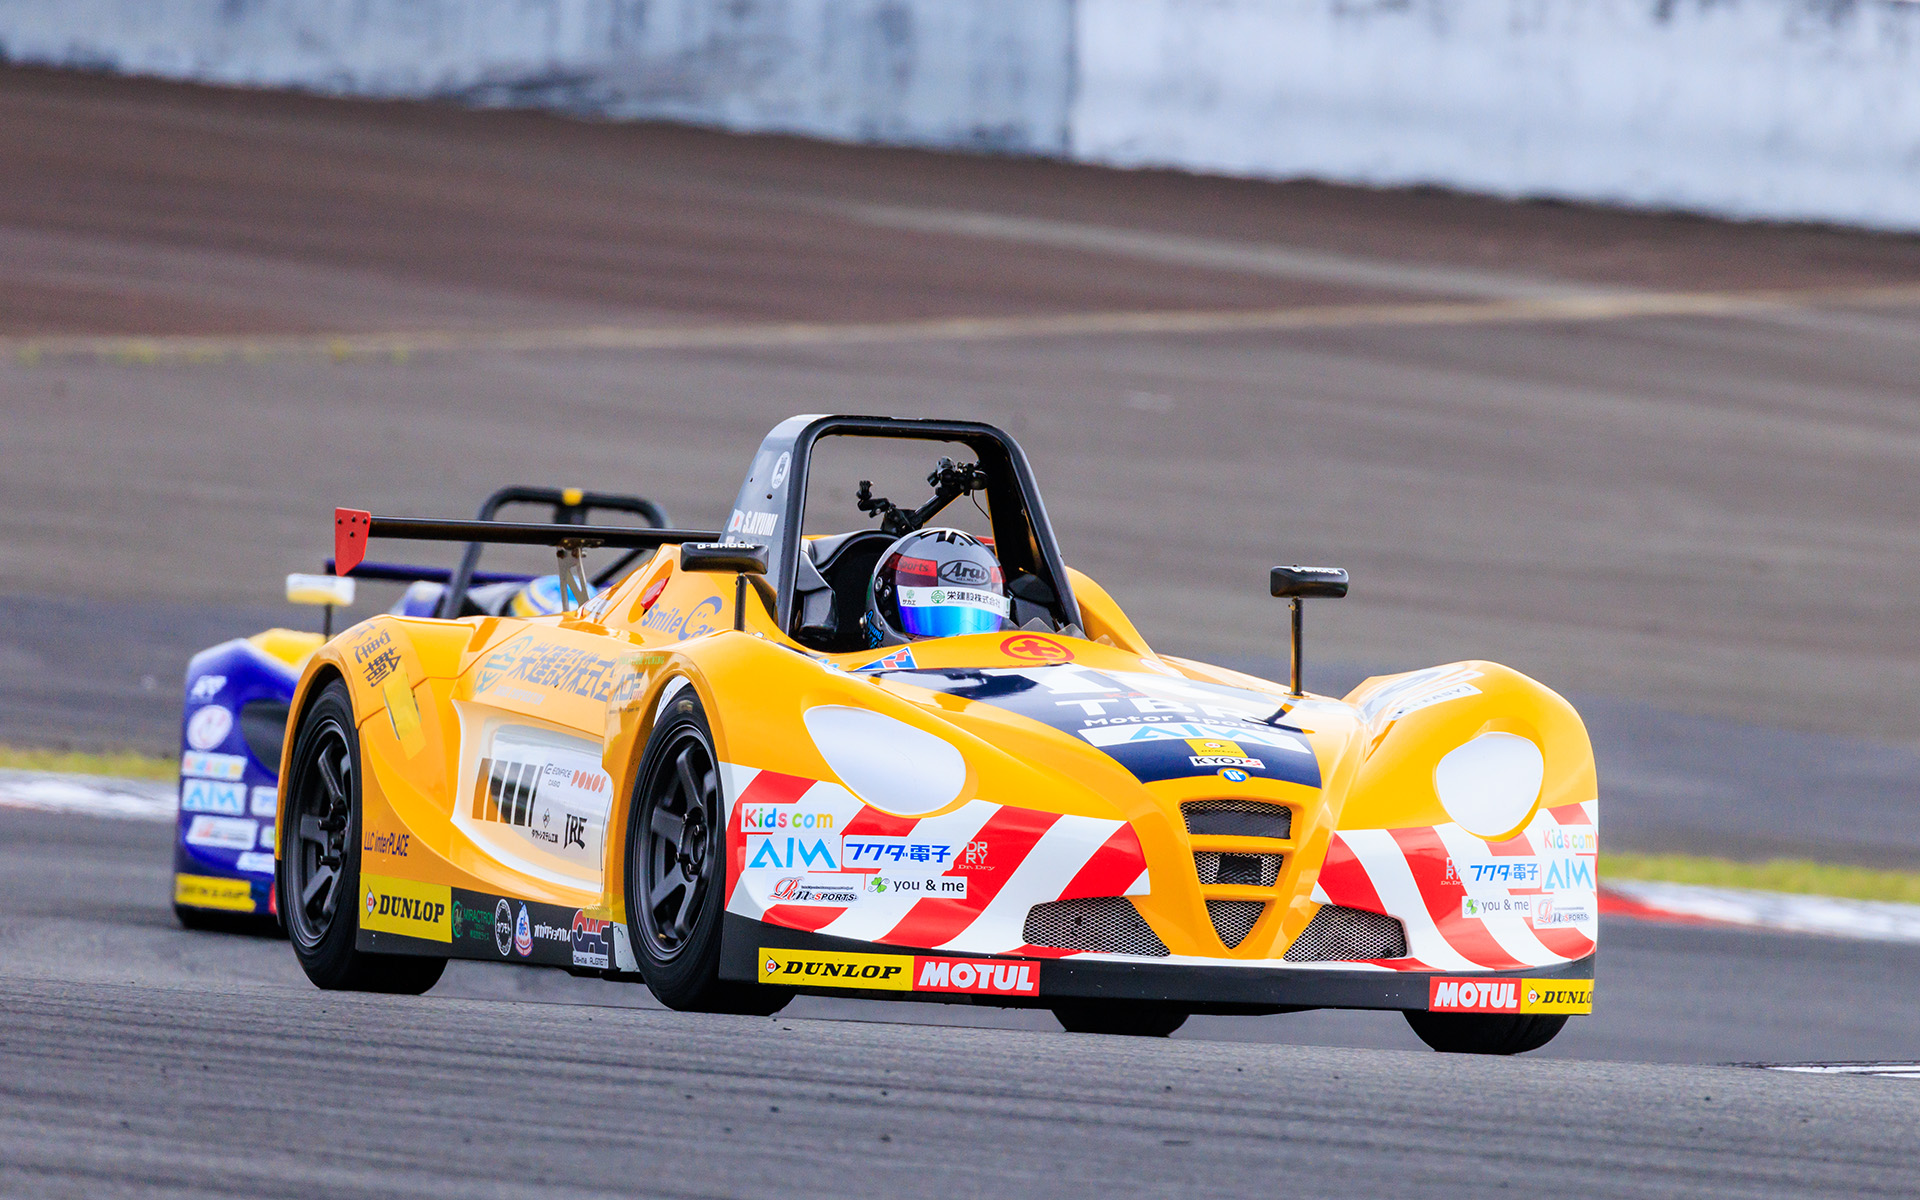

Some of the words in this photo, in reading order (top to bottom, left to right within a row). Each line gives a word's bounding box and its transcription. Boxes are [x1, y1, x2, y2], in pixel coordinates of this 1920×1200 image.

[947, 561, 986, 580] Arai
[641, 603, 683, 634] Smile
[1055, 697, 1262, 721] TBR
[1084, 713, 1174, 727] Motor
[552, 766, 572, 778] EDIFICE
[570, 769, 607, 793] PONOS
[744, 807, 787, 829] Kids
[792, 811, 833, 829] com
[364, 831, 374, 851] LLC
[1544, 829, 1570, 849] Kids
[1572, 833, 1595, 849] com
[748, 837, 837, 868] AIM
[893, 879, 920, 892] you
[926, 878, 937, 891] &
[941, 880, 965, 892] me
[1544, 858, 1594, 889] AIM
[378, 893, 445, 924] DUNLOP
[1481, 900, 1500, 913] you
[1503, 899, 1512, 911] &
[1514, 900, 1529, 911] me
[783, 960, 902, 979] DUNLOP
[918, 961, 1034, 991] MOTUL
[1434, 982, 1519, 1009] MOTUL
